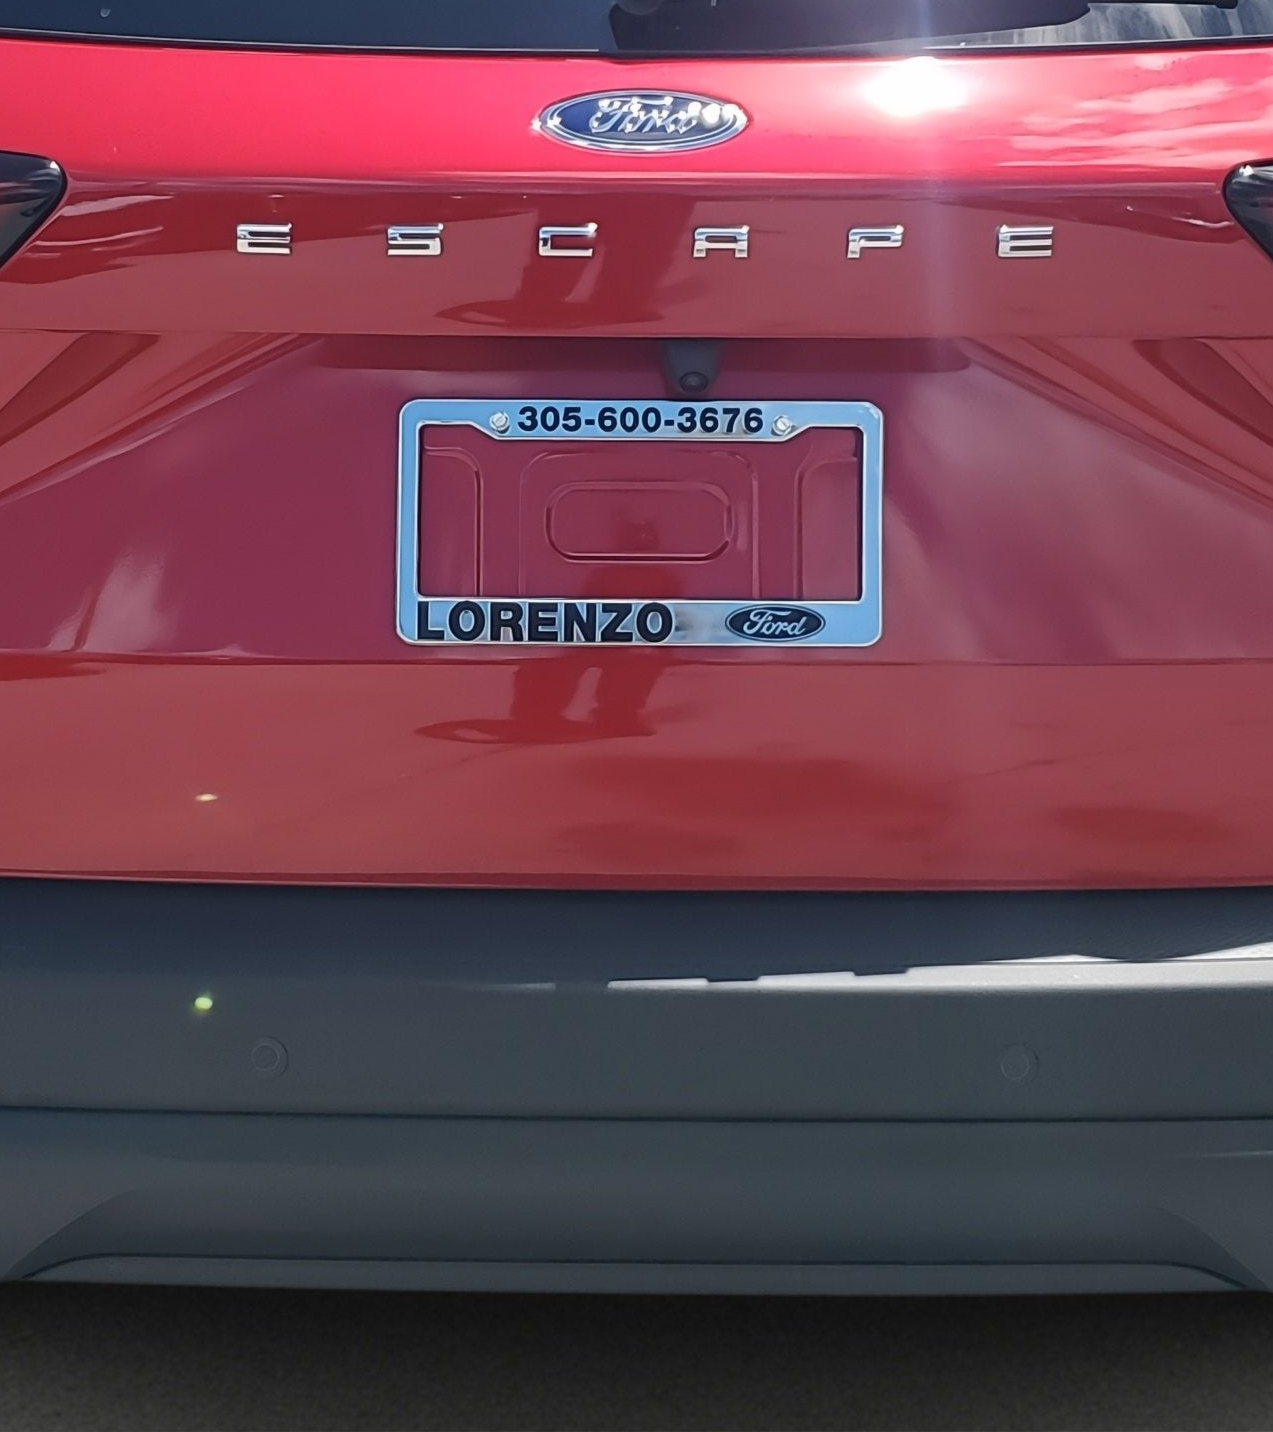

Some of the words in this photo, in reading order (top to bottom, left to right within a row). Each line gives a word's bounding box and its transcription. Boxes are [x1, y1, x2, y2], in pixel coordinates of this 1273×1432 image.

[588, 96, 702, 135] Ford
[234, 220, 1057, 260] ESCAPE
[516, 405, 765, 434] 305-600-3676
[416, 599, 674, 643] LORENZO
[741, 608, 807, 636] Ford
